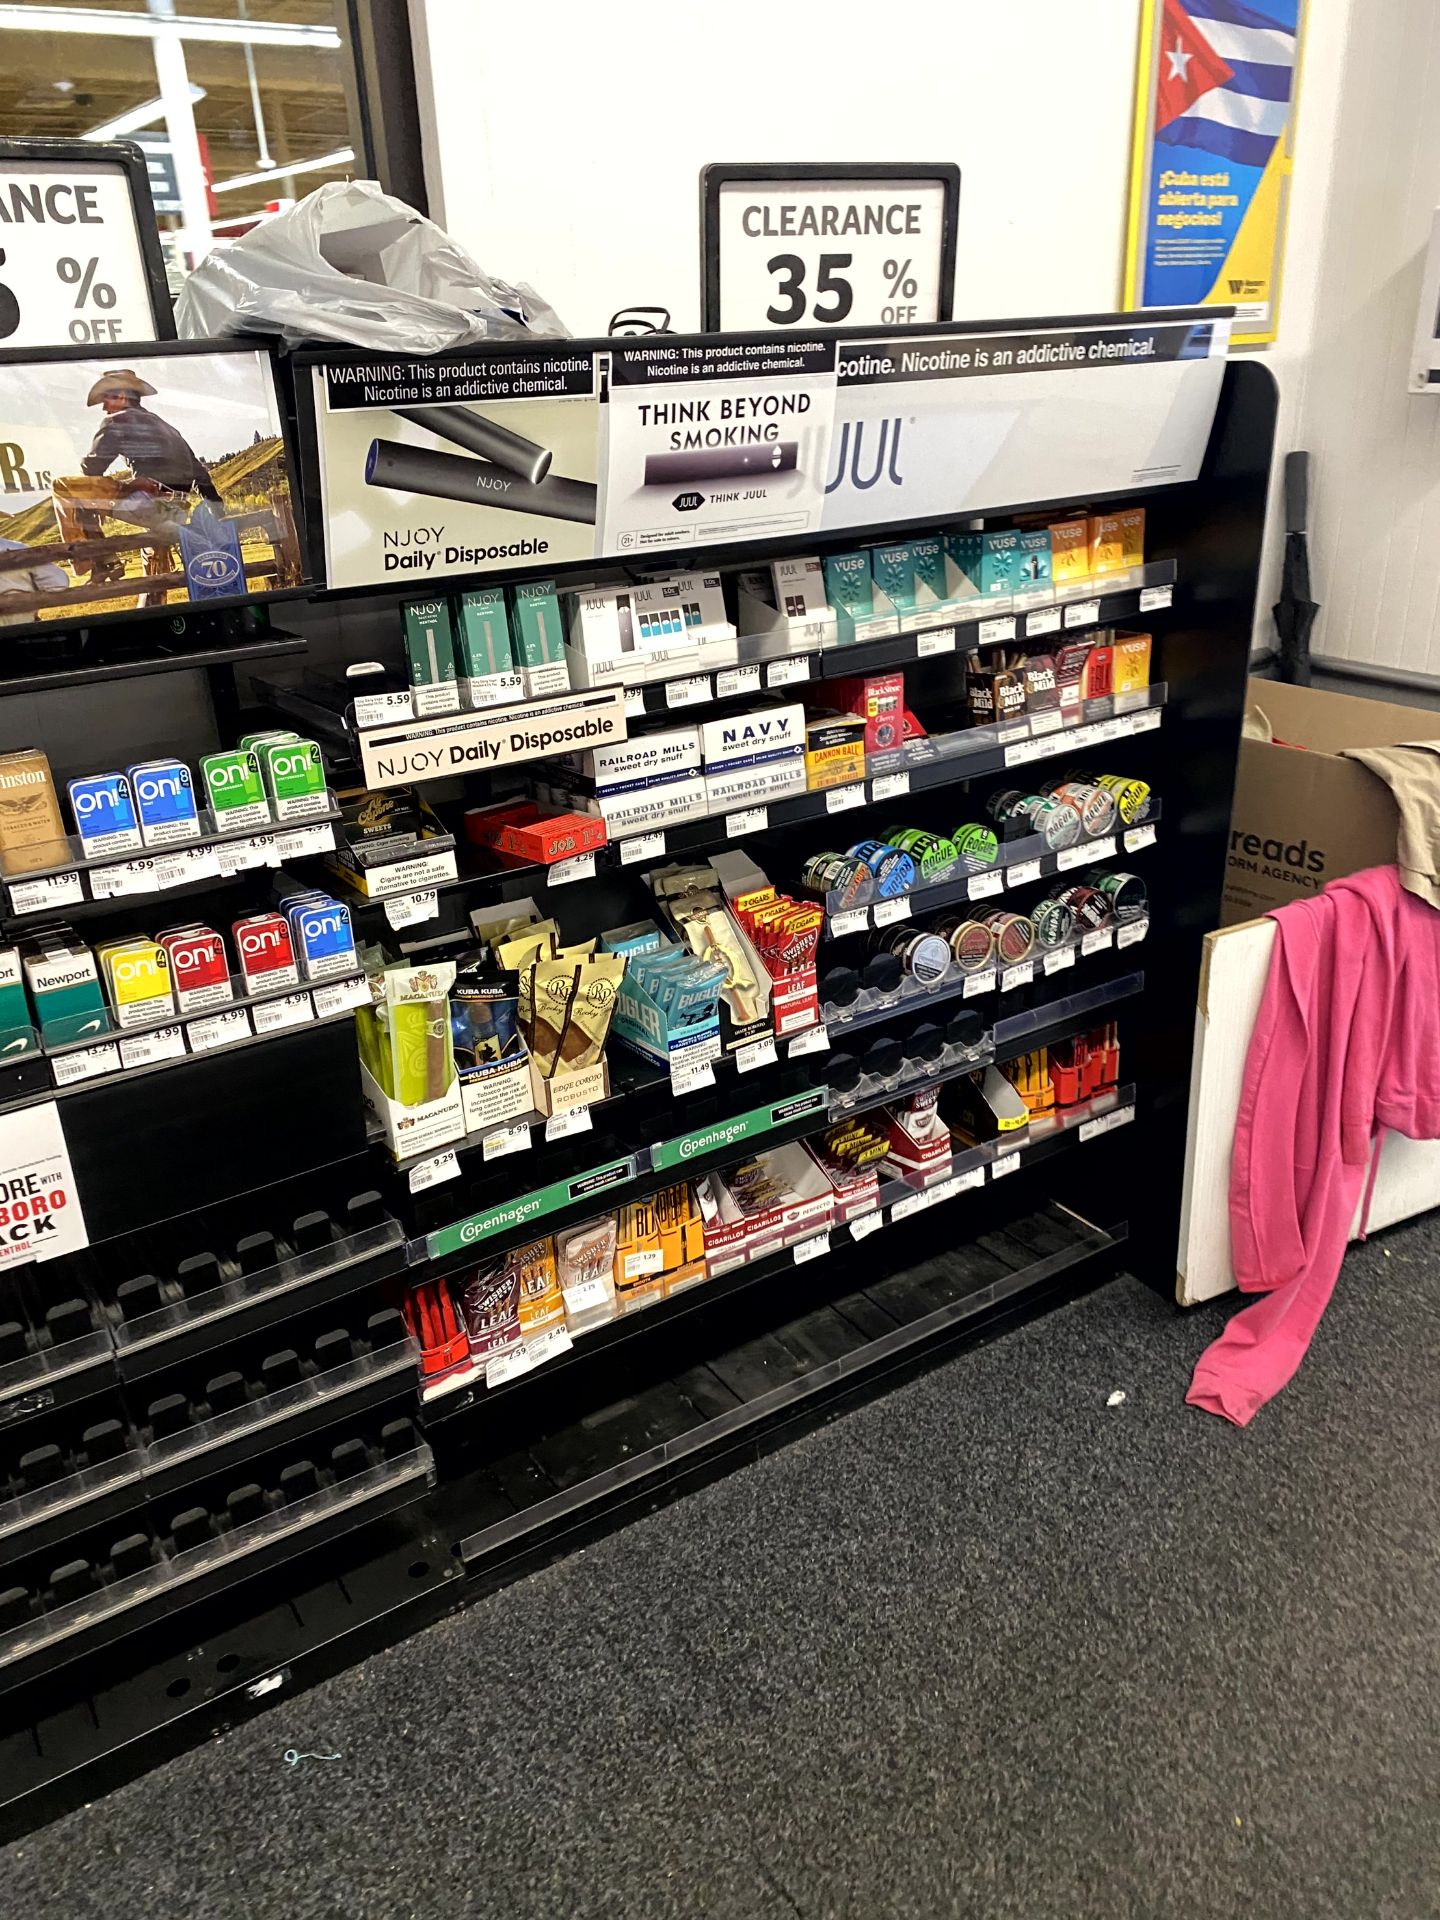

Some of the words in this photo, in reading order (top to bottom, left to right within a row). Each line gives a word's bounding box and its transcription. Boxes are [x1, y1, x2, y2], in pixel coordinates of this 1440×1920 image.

[0, 183, 105, 225] NCE
[1157, 192, 1206, 207] abierta
[1206, 194, 1239, 209] para
[742, 205, 922, 237] CLEARANCE
[1156, 212, 1222, 229] negocios!
[766, 253, 853, 325] 35
[882, 259, 918, 299] %
[881, 305, 918, 326] OFF
[68, 318, 123, 344] OFF
[624, 348, 679, 363] WARNING:
[682, 347, 703, 359] This
[705, 345, 743, 360] product
[745, 343, 785, 356] contains
[787, 340, 826, 354] nicotine.
[901, 347, 971, 374] Nicotine
[973, 347, 988, 367] is
[992, 347, 1012, 367] an
[1016, 342, 1086, 365] addictive
[1088, 336, 1156, 360] chemical.
[329, 365, 406, 384] WARNING:
[408, 363, 436, 381] This
[438, 361, 487, 381] product
[489, 359, 541, 377] contains
[543, 356, 593, 374] nicotine.
[647, 362, 689, 377] Nicotine
[691, 363, 700, 374] is
[702, 363, 714, 374] an
[716, 359, 760, 373] addictive
[762, 356, 805, 370] chemical.
[364, 383, 419, 402] Nicotine
[421, 383, 433, 399] is
[435, 385, 451, 397] an
[454, 378, 510, 397] addictive
[512, 375, 568, 393] chemical.
[638, 401, 712, 427] THINK
[719, 393, 811, 420] BEYOND
[670, 422, 780, 452] SMOKING
[36, 470, 52, 492] IS
[476, 475, 512, 492] NJOY
[678, 494, 700, 509] JUUL
[709, 491, 740, 505] THINK
[743, 488, 768, 502] JUUL
[383, 525, 446, 549] NJOY
[385, 550, 437, 572] Daily
[445, 537, 550, 566] Disposable
[201, 560, 228, 580] 70
[467, 593, 500, 608] NJOY
[521, 584, 552, 600] NJOY
[410, 602, 444, 617] NJOY
[499, 676, 522, 688] 5.59
[1027, 667, 1055, 682] Black
[969, 687, 993, 699] Black
[1000, 682, 1026, 698] Black
[1033, 678, 1056, 692] Mild
[386, 694, 411, 706] 5.59
[974, 696, 994, 710] Mild
[1004, 692, 1026, 707] Mild
[405, 730, 435, 741] WARNING:
[435, 728, 446, 736] This
[446, 724, 466, 734] product
[466, 720, 488, 729] contains
[488, 716, 509, 727] nicotine.
[509, 713, 530, 722] Nicotine
[541, 705, 563, 716] addictive
[563, 702, 586, 712] chemical.
[722, 717, 790, 745] NAVY
[377, 749, 444, 779] NJOY
[450, 740, 502, 765] Daily
[510, 716, 614, 752] Disposable
[721, 741, 751, 753] sweet
[752, 737, 768, 750] dry
[768, 730, 792, 743] snuff
[272, 753, 313, 777] on!
[310, 744, 320, 759] 2
[599, 750, 658, 768] RAILROAD
[663, 741, 696, 755] MILLS
[613, 762, 642, 773] sweet
[643, 757, 660, 771] dry
[660, 752, 683, 765] snuff
[814, 746, 842, 765] CANNON
[842, 744, 860, 758] BALL
[712, 779, 767, 798] RAILROAD
[770, 769, 802, 785] MILLS
[725, 790, 752, 802] sweet
[752, 786, 768, 800] dry
[769, 781, 792, 793] snuff
[363, 823, 393, 835] SWEETS
[186, 844, 214, 859] 4.99
[249, 836, 274, 849] 4.99
[548, 837, 577, 856] JOB
[1231, 830, 1326, 873] reads
[126, 860, 155, 873] 4.99
[395, 861, 429, 873] WARNING:
[574, 853, 595, 864] 4.29
[922, 846, 954, 872] ROGUE
[46, 873, 78, 887] 11.99
[1261, 863, 1321, 890] AGENCY
[411, 890, 437, 904] 10.79
[305, 916, 341, 938] on!
[340, 908, 349, 920] 2
[782, 933, 816, 960] SWISHER
[36, 967, 92, 989] Newport
[343, 975, 367, 990] 4.99
[787, 981, 807, 994] LEAF
[284, 991, 309, 1006] 4.99
[220, 1009, 246, 1024] 4.99
[153, 1026, 180, 1041] 4.99
[757, 1039, 774, 1051] 3.09
[468, 1067, 496, 1081] KUBA
[497, 1058, 523, 1072] KUBA
[690, 1062, 710, 1075] 11.49
[552, 1080, 572, 1096] EDGE
[571, 1073, 604, 1089] COROJO
[556, 1086, 600, 1105] ROBUSTO
[416, 1103, 460, 1124] MACANUDO
[569, 1104, 590, 1118] 6.29
[508, 1123, 529, 1137] 8.99
[680, 1121, 746, 1158] Copenhagen
[433, 1152, 455, 1168] 9.29
[40, 1172, 63, 1186] WITH
[802, 1199, 832, 1216] PERFECTO
[460, 1199, 541, 1242] Copenhagen
[747, 1214, 783, 1233] CIGARILLOS
[707, 1230, 745, 1248] CIGARILLOS
[480, 1303, 516, 1331] LEAF
[487, 1334, 511, 1351] LEAF
